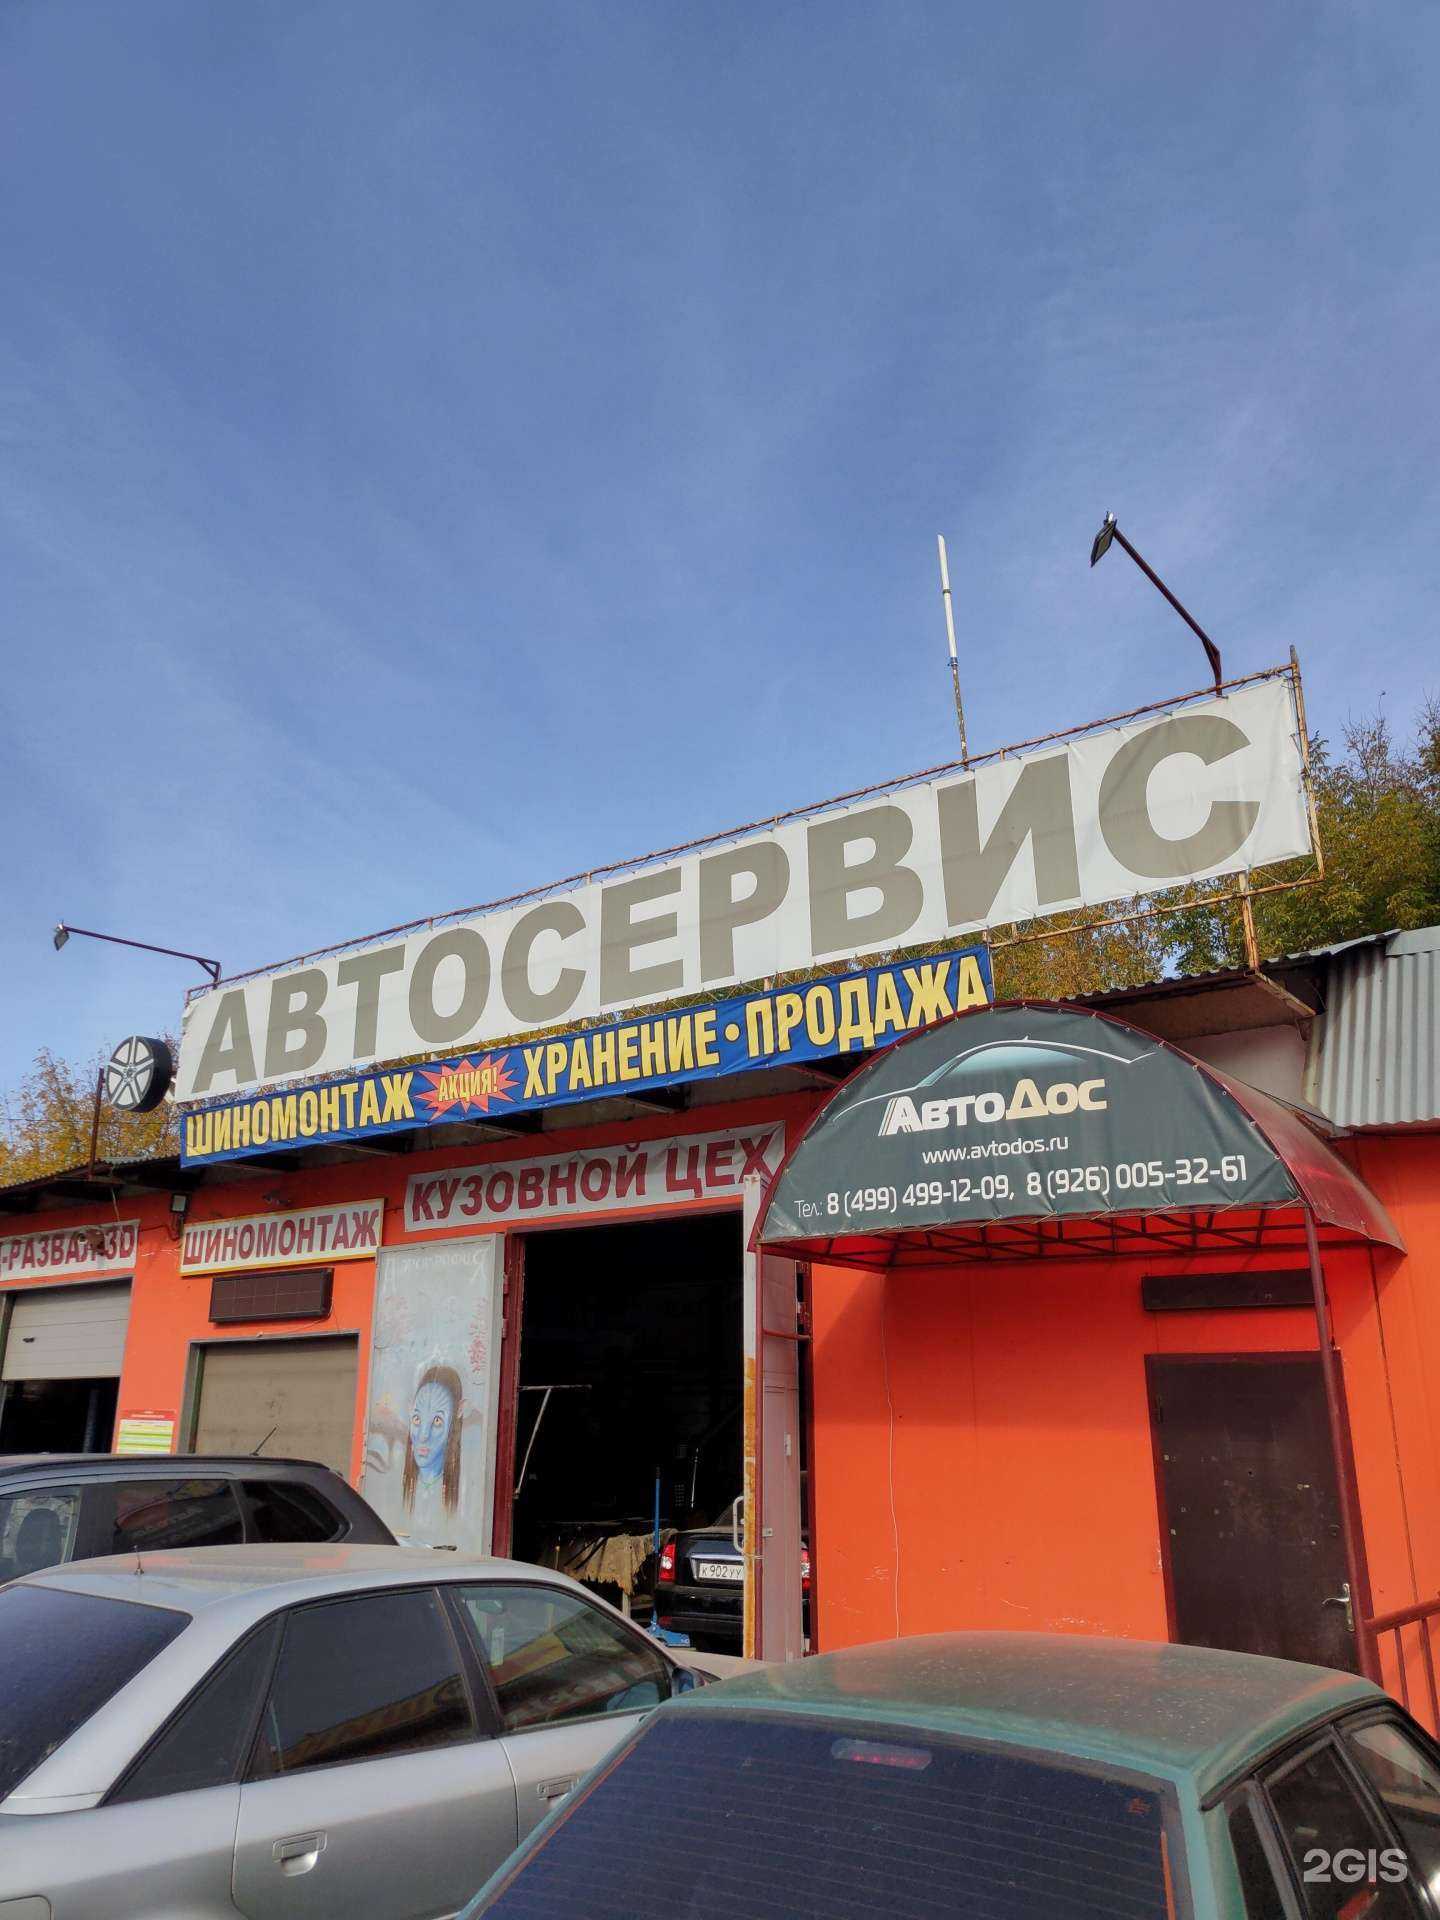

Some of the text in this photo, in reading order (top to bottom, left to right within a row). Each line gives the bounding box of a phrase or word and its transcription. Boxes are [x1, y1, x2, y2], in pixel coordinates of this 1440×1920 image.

[190, 714, 1262, 1094] АВТОСЕРВИС
[186, 955, 988, 1157] ШИНОМОНТАЖ АКЦИЯ! ХРАНЕНИЕ ПРОДАЖА
[412, 1133, 775, 1222] КУЗОВНОЙ ЦЕХ
[827, 1192, 839, 1215] 8
[844, 1186, 897, 1217] (499)
[902, 1174, 1015, 1207] 499-12-09,
[1026, 1172, 1042, 1196] 8
[1047, 1165, 1110, 1199] (926)
[1115, 1154, 1247, 1189] 005-32-61
[922, 1136, 1069, 1164] www.avtodos.ru
[183, 1209, 379, 1266] ШИНОМОНТАЖ
